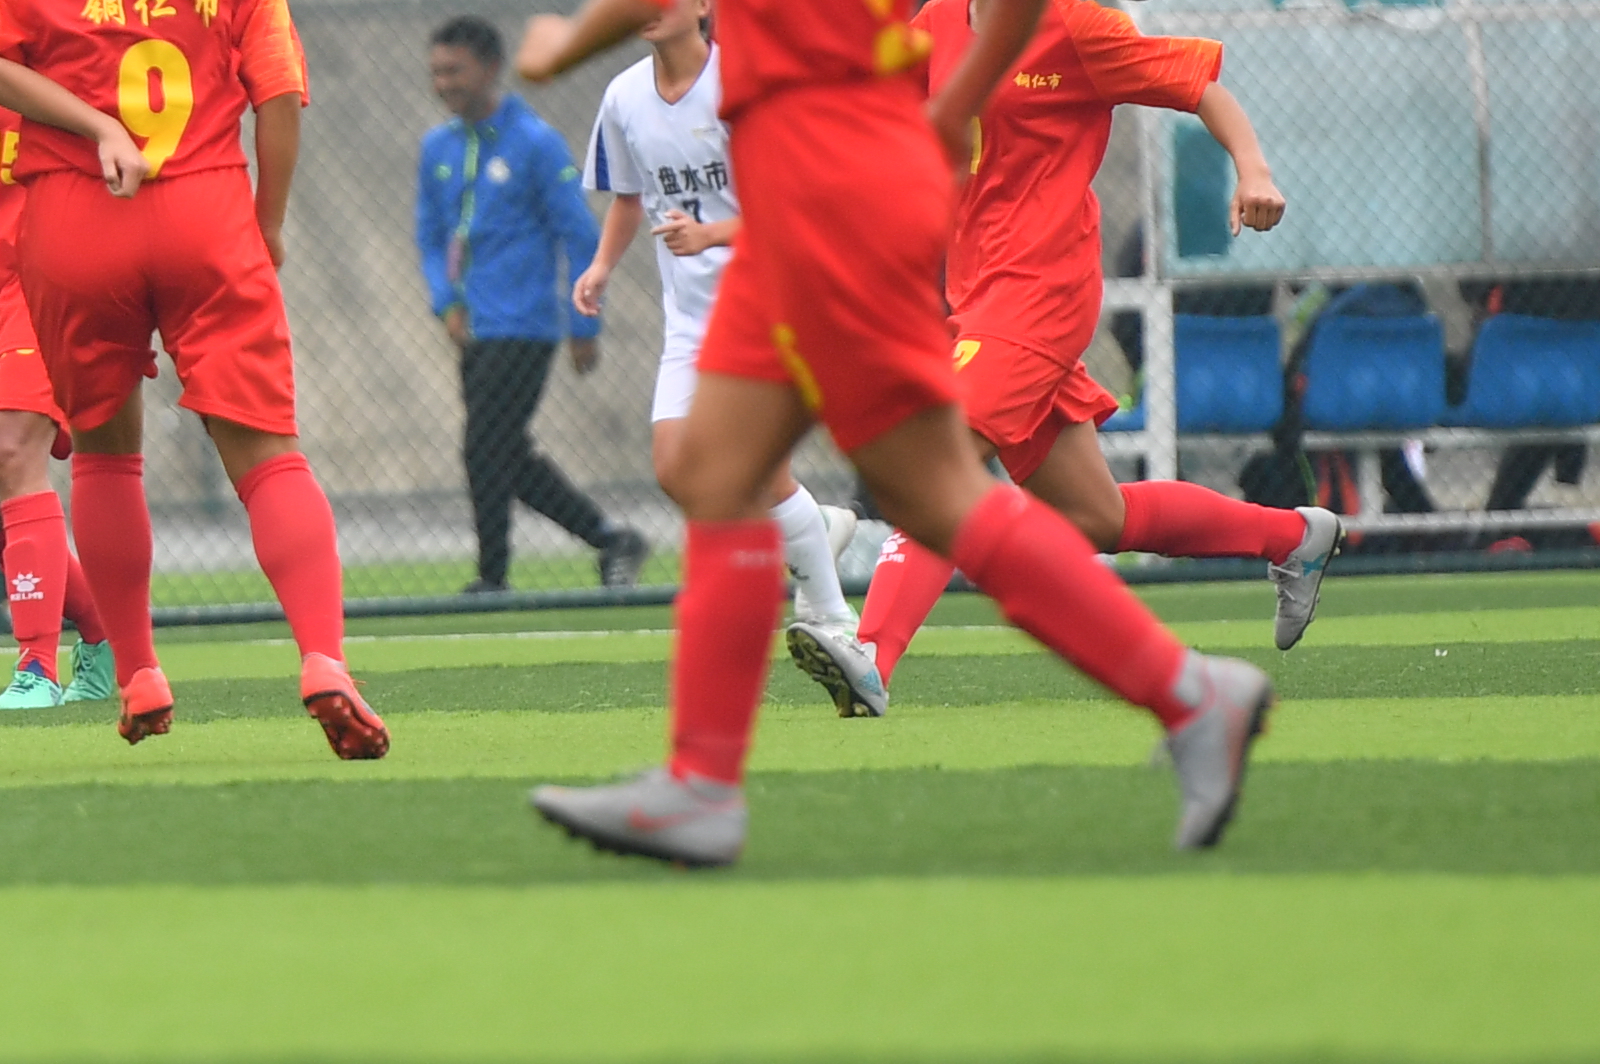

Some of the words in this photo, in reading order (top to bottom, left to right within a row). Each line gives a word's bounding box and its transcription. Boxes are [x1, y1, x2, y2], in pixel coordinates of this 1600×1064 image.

[1012, 71, 1062, 90] 铜仁市
[118, 39, 194, 178] 9
[648, 161, 728, 195] 盘水市
[681, 198, 703, 224] 7
